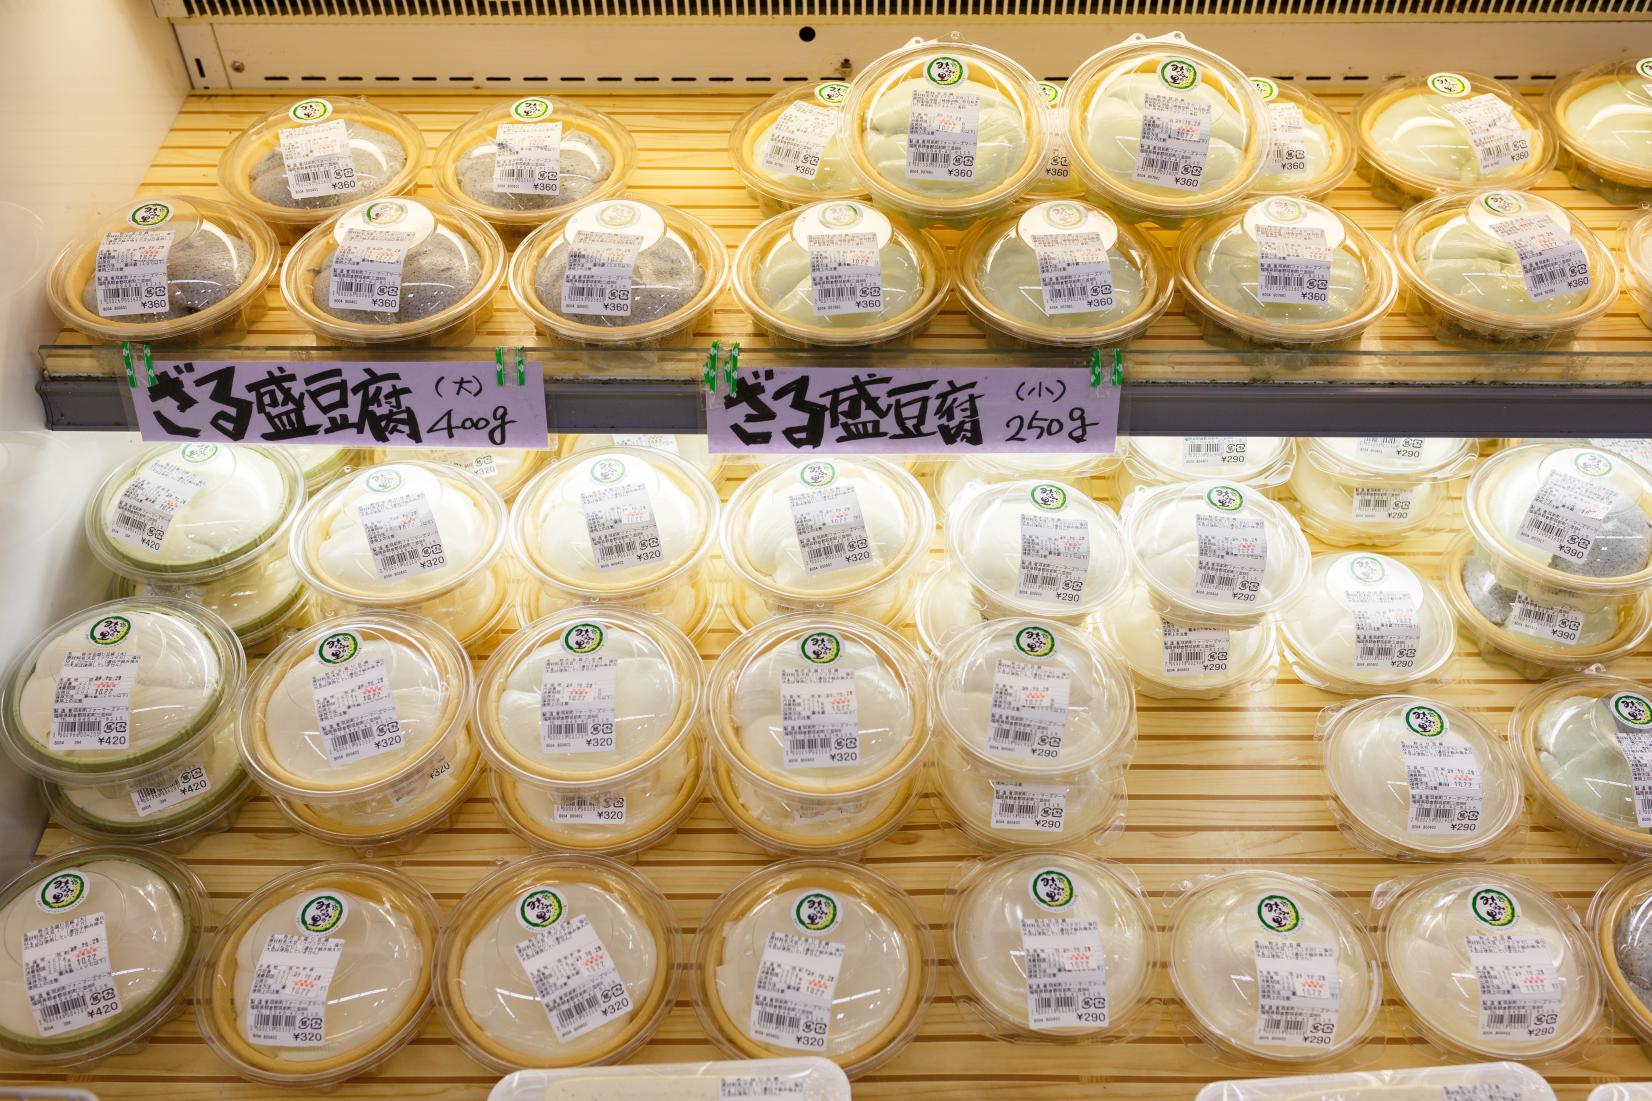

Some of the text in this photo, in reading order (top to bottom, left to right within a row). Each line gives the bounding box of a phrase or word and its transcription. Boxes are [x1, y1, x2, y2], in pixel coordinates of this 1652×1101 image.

[795, 164, 816, 176] ¥360
[1282, 161, 1305, 171] ¥360
[948, 169, 973, 178] ¥360
[331, 179, 356, 190] ¥360
[533, 183, 557, 192] ¥360
[1175, 176, 1199, 188] ¥360
[1567, 276, 1590, 288] ¥360
[1086, 296, 1113, 308] ¥360
[1301, 292, 1326, 302] ¥360
[141, 299, 167, 310] ¥360
[372, 299, 397, 310] ¥360
[603, 303, 629, 312] ¥360
[856, 300, 881, 309] ¥360
[148, 362, 422, 444] ざる盛豆腐
[724, 368, 986, 448] ざる盛豆腐
[426, 405, 518, 445] 400g
[1004, 408, 1100, 444] 250g
[1221, 454, 1245, 464] ¥290
[1396, 449, 1421, 459] ¥290
[140, 536, 160, 550] ¥420
[637, 550, 661, 562] ¥320
[845, 551, 870, 563] ¥320
[1559, 544, 1584, 560] ¥390
[420, 556, 445, 568] ¥320
[1056, 592, 1080, 603] ¥290
[1232, 592, 1256, 602] ¥290
[1551, 628, 1576, 642] ¥390
[1203, 662, 1227, 672] ¥290
[1391, 659, 1414, 669] ¥290
[98, 736, 126, 746] ¥420
[374, 735, 402, 750] ¥320
[586, 738, 613, 747] ¥320
[830, 752, 858, 762] ¥320
[1031, 747, 1058, 758] ¥290
[180, 780, 207, 796] ¥420
[597, 811, 624, 820] ¥320
[1035, 819, 1061, 829] ¥290
[1450, 822, 1476, 832] ¥290
[88, 1001, 118, 1018] ¥420
[601, 997, 630, 1016] ¥320
[1077, 1011, 1106, 1022] ¥290
[292, 1031, 322, 1043] ¥320
[1528, 1027, 1555, 1037] ¥290
[796, 1036, 824, 1048] ¥320
[1303, 1034, 1331, 1045] ¥290
